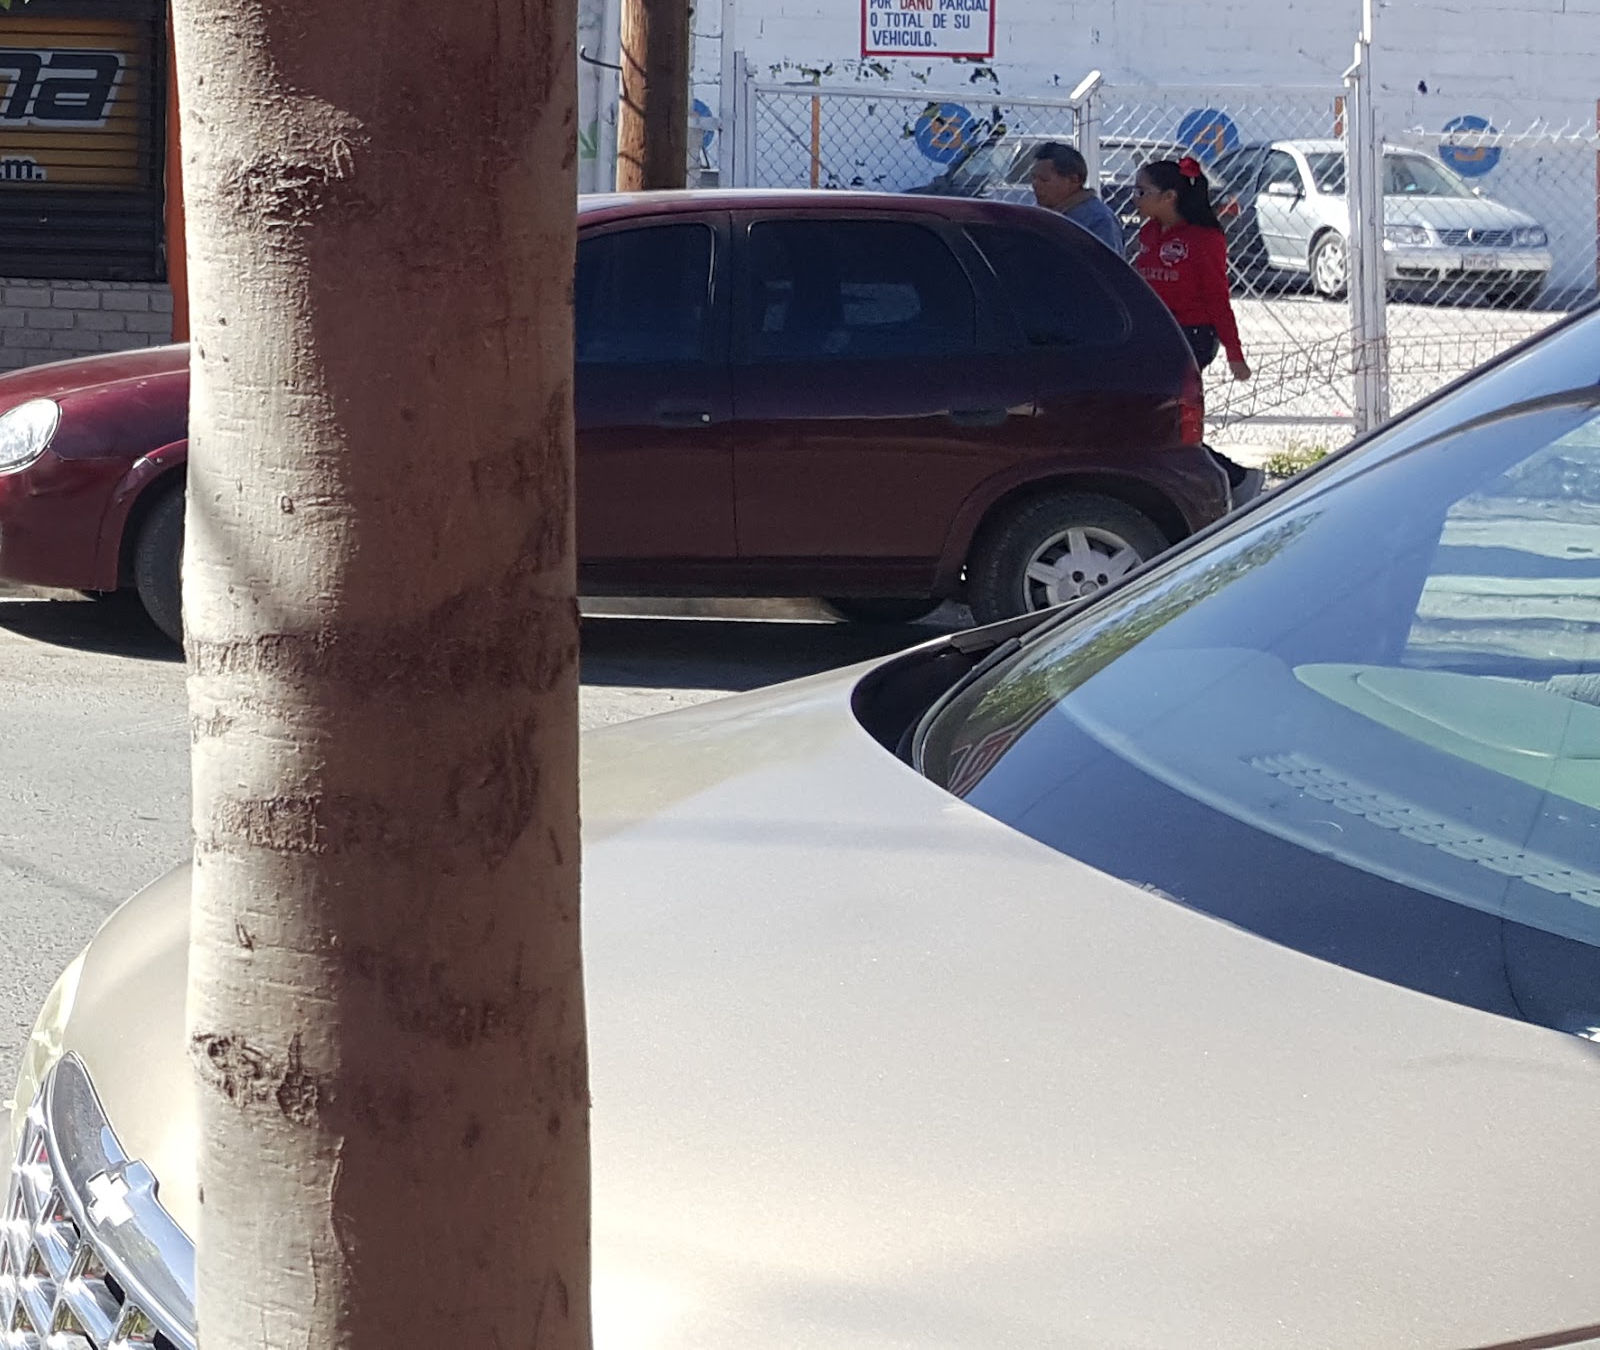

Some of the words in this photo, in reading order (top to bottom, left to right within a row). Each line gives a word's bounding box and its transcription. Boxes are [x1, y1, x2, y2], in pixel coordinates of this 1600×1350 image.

[870, 12, 878, 28] O
[885, 12, 925, 29] TOTAL
[933, 13, 947, 29] DE
[954, 14, 970, 29] SU
[872, 30, 938, 48] VEHICULO.
